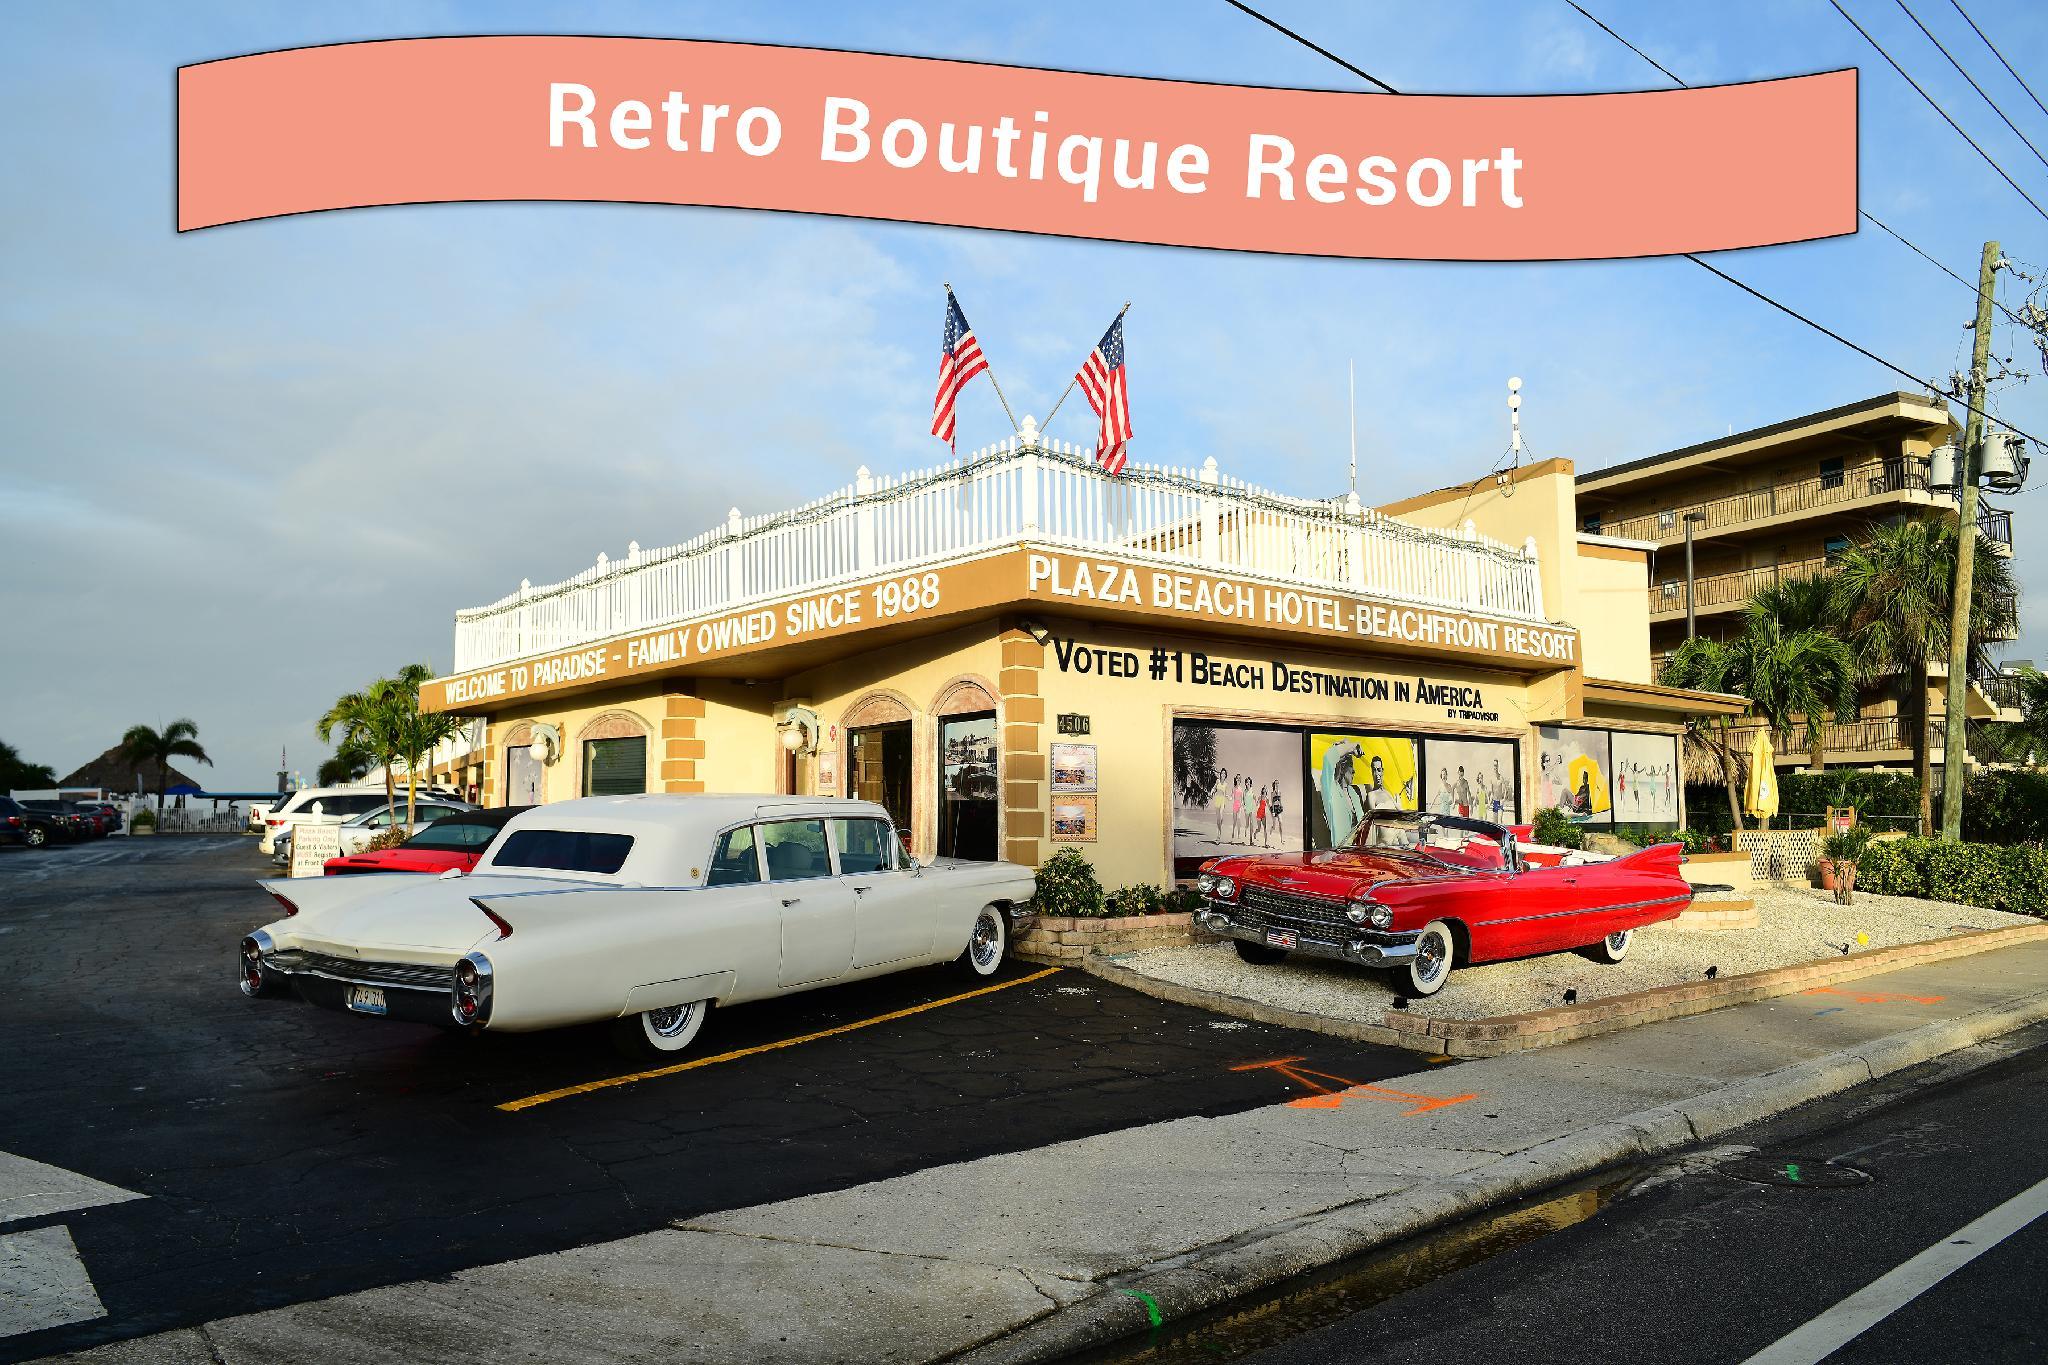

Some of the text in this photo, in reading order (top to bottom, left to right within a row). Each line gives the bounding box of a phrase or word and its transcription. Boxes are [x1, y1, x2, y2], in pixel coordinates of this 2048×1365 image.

[445, 670, 506, 704] WELCOME
[510, 666, 528, 692] TO
[533, 648, 606, 687] PARADISE
[627, 628, 690, 669] FAMILY
[696, 609, 776, 654] OWNED
[785, 590, 861, 637] SINCE
[872, 572, 940, 618] 1988
[1028, 553, 1142, 606] PLAZA
[1152, 571, 1255, 620] BEACH
[1504, 625, 1576, 661] RESORT
[1053, 637, 1483, 709] VOTED #1 BEACH DESTINATION IN AMERICA
[1059, 714, 1089, 732] 4506
[1447, 708, 1499, 722] BY TRIPADVISOR
